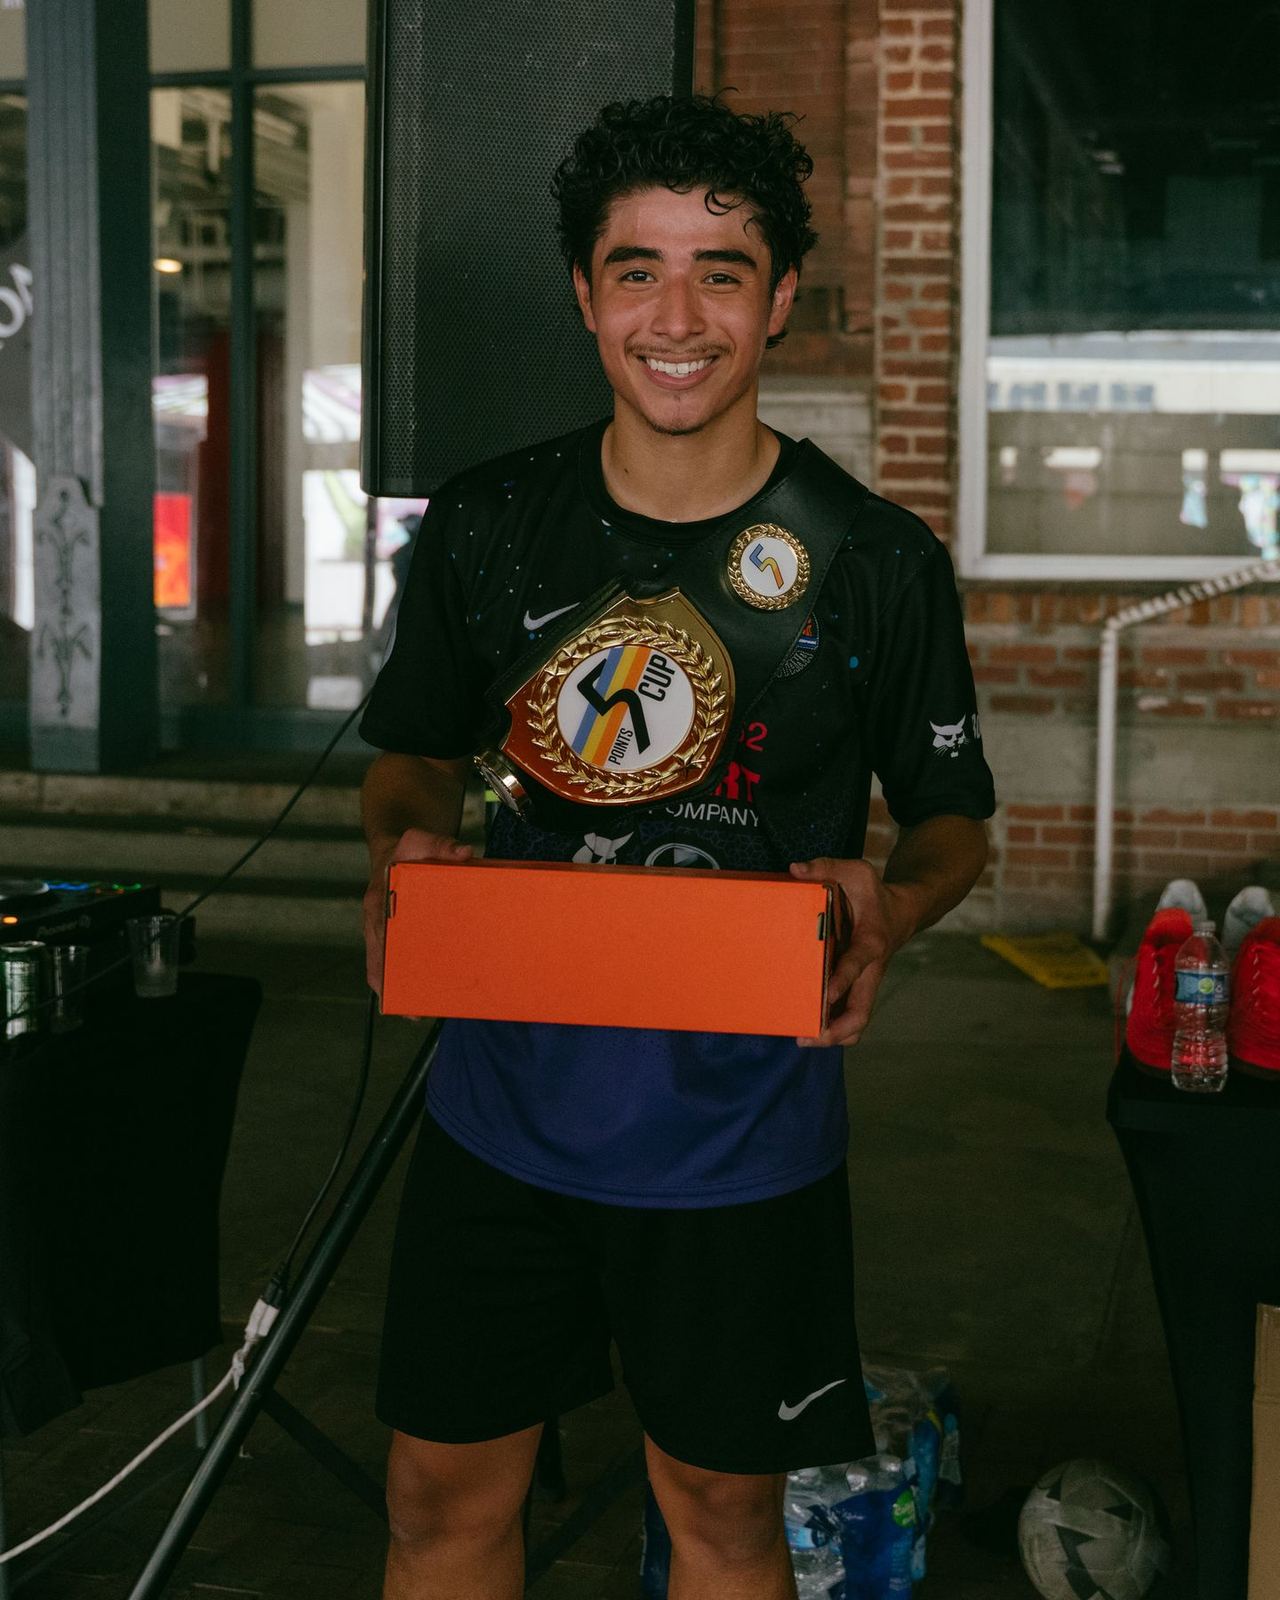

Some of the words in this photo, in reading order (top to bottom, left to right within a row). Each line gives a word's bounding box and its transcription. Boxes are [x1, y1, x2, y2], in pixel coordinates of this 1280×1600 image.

[608, 728, 633, 765] POINTS
[638, 654, 675, 702] CUP
[738, 721, 768, 752] 2
[665, 802, 759, 827] OMPANY
